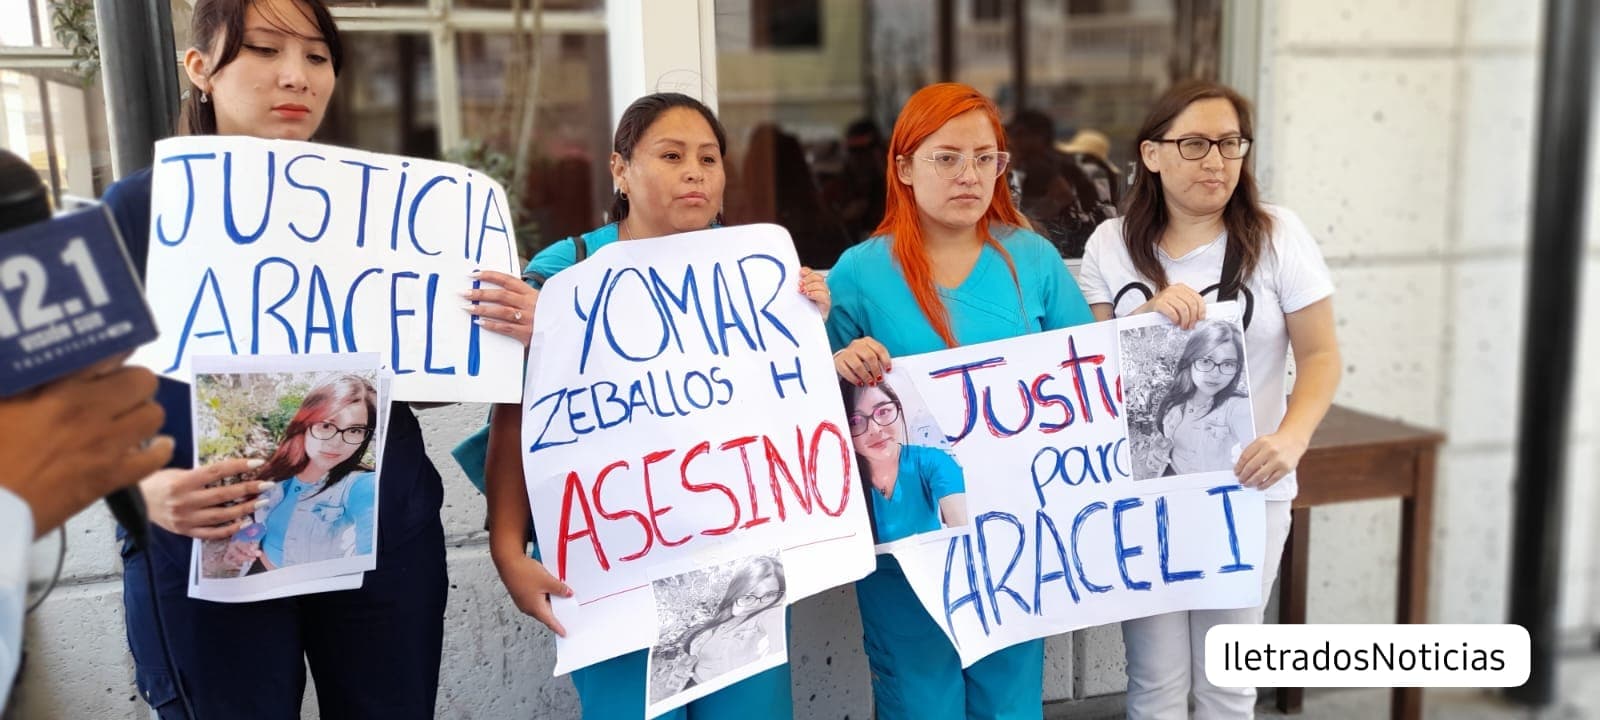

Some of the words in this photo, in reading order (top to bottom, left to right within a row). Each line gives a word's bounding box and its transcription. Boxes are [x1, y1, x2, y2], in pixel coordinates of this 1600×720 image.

[163, 257, 481, 376] ARACELI
[575, 254, 800, 374] YOMAR
[530, 366, 733, 453] ZEBALLOS
[771, 357, 807, 399] H
[928, 335, 1123, 445] Justi
[557, 420, 851, 581] ASESINO
[943, 484, 1255, 648] ARACELI
